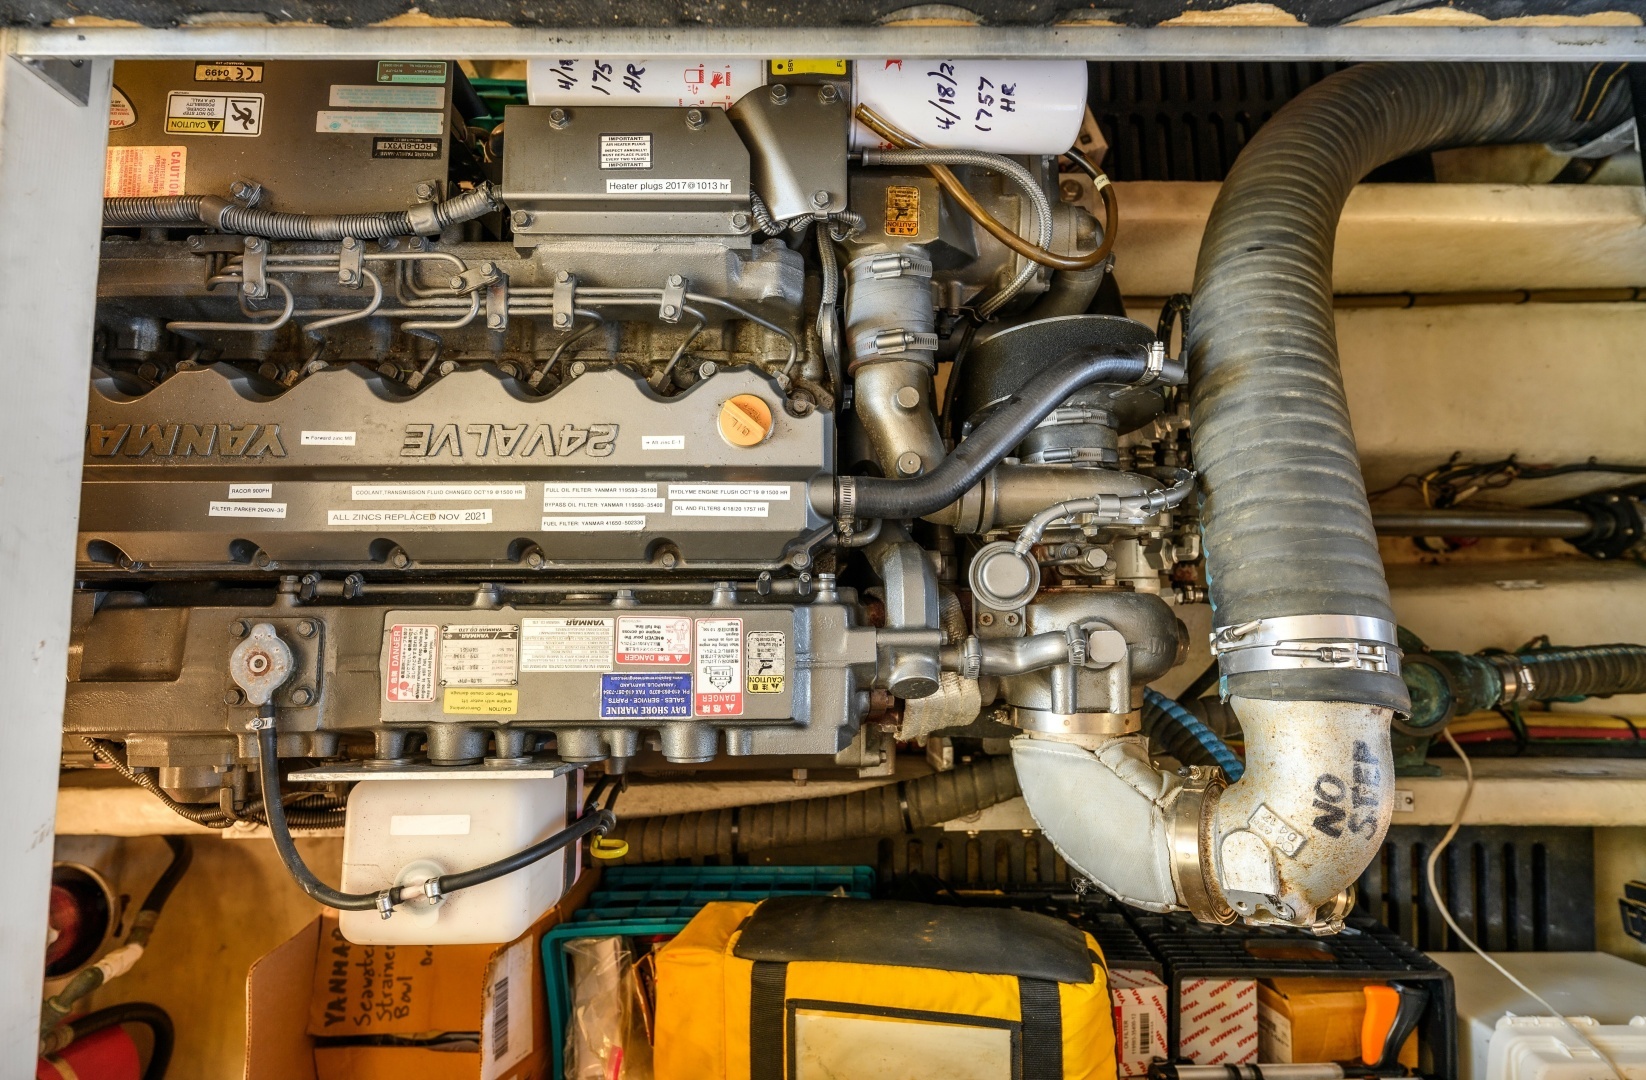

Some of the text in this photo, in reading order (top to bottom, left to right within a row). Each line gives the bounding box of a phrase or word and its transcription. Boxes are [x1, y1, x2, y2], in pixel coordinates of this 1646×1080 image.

[205, 68, 230, 77] 0499
[623, 64, 645, 93] HR
[1000, 83, 1016, 112] HR
[171, 120, 206, 128] CAUTION
[640, 182, 663, 192] plugs
[720, 181, 729, 190] hr
[732, 417, 749, 436] OIL
[86, 424, 287, 457] YANMA
[392, 630, 401, 666] DANGER
[606, 707, 638, 715] MARINE
[1348, 740, 1381, 841] STEP
[1311, 772, 1346, 839] NO
[354, 945, 375, 1026] Seawate
[394, 976, 413, 1019] Bowl
[1192, 1001, 1226, 1023] YANMAR
[1220, 1002, 1254, 1023] YANMAR
[1210, 1024, 1242, 1047] YANMAR
